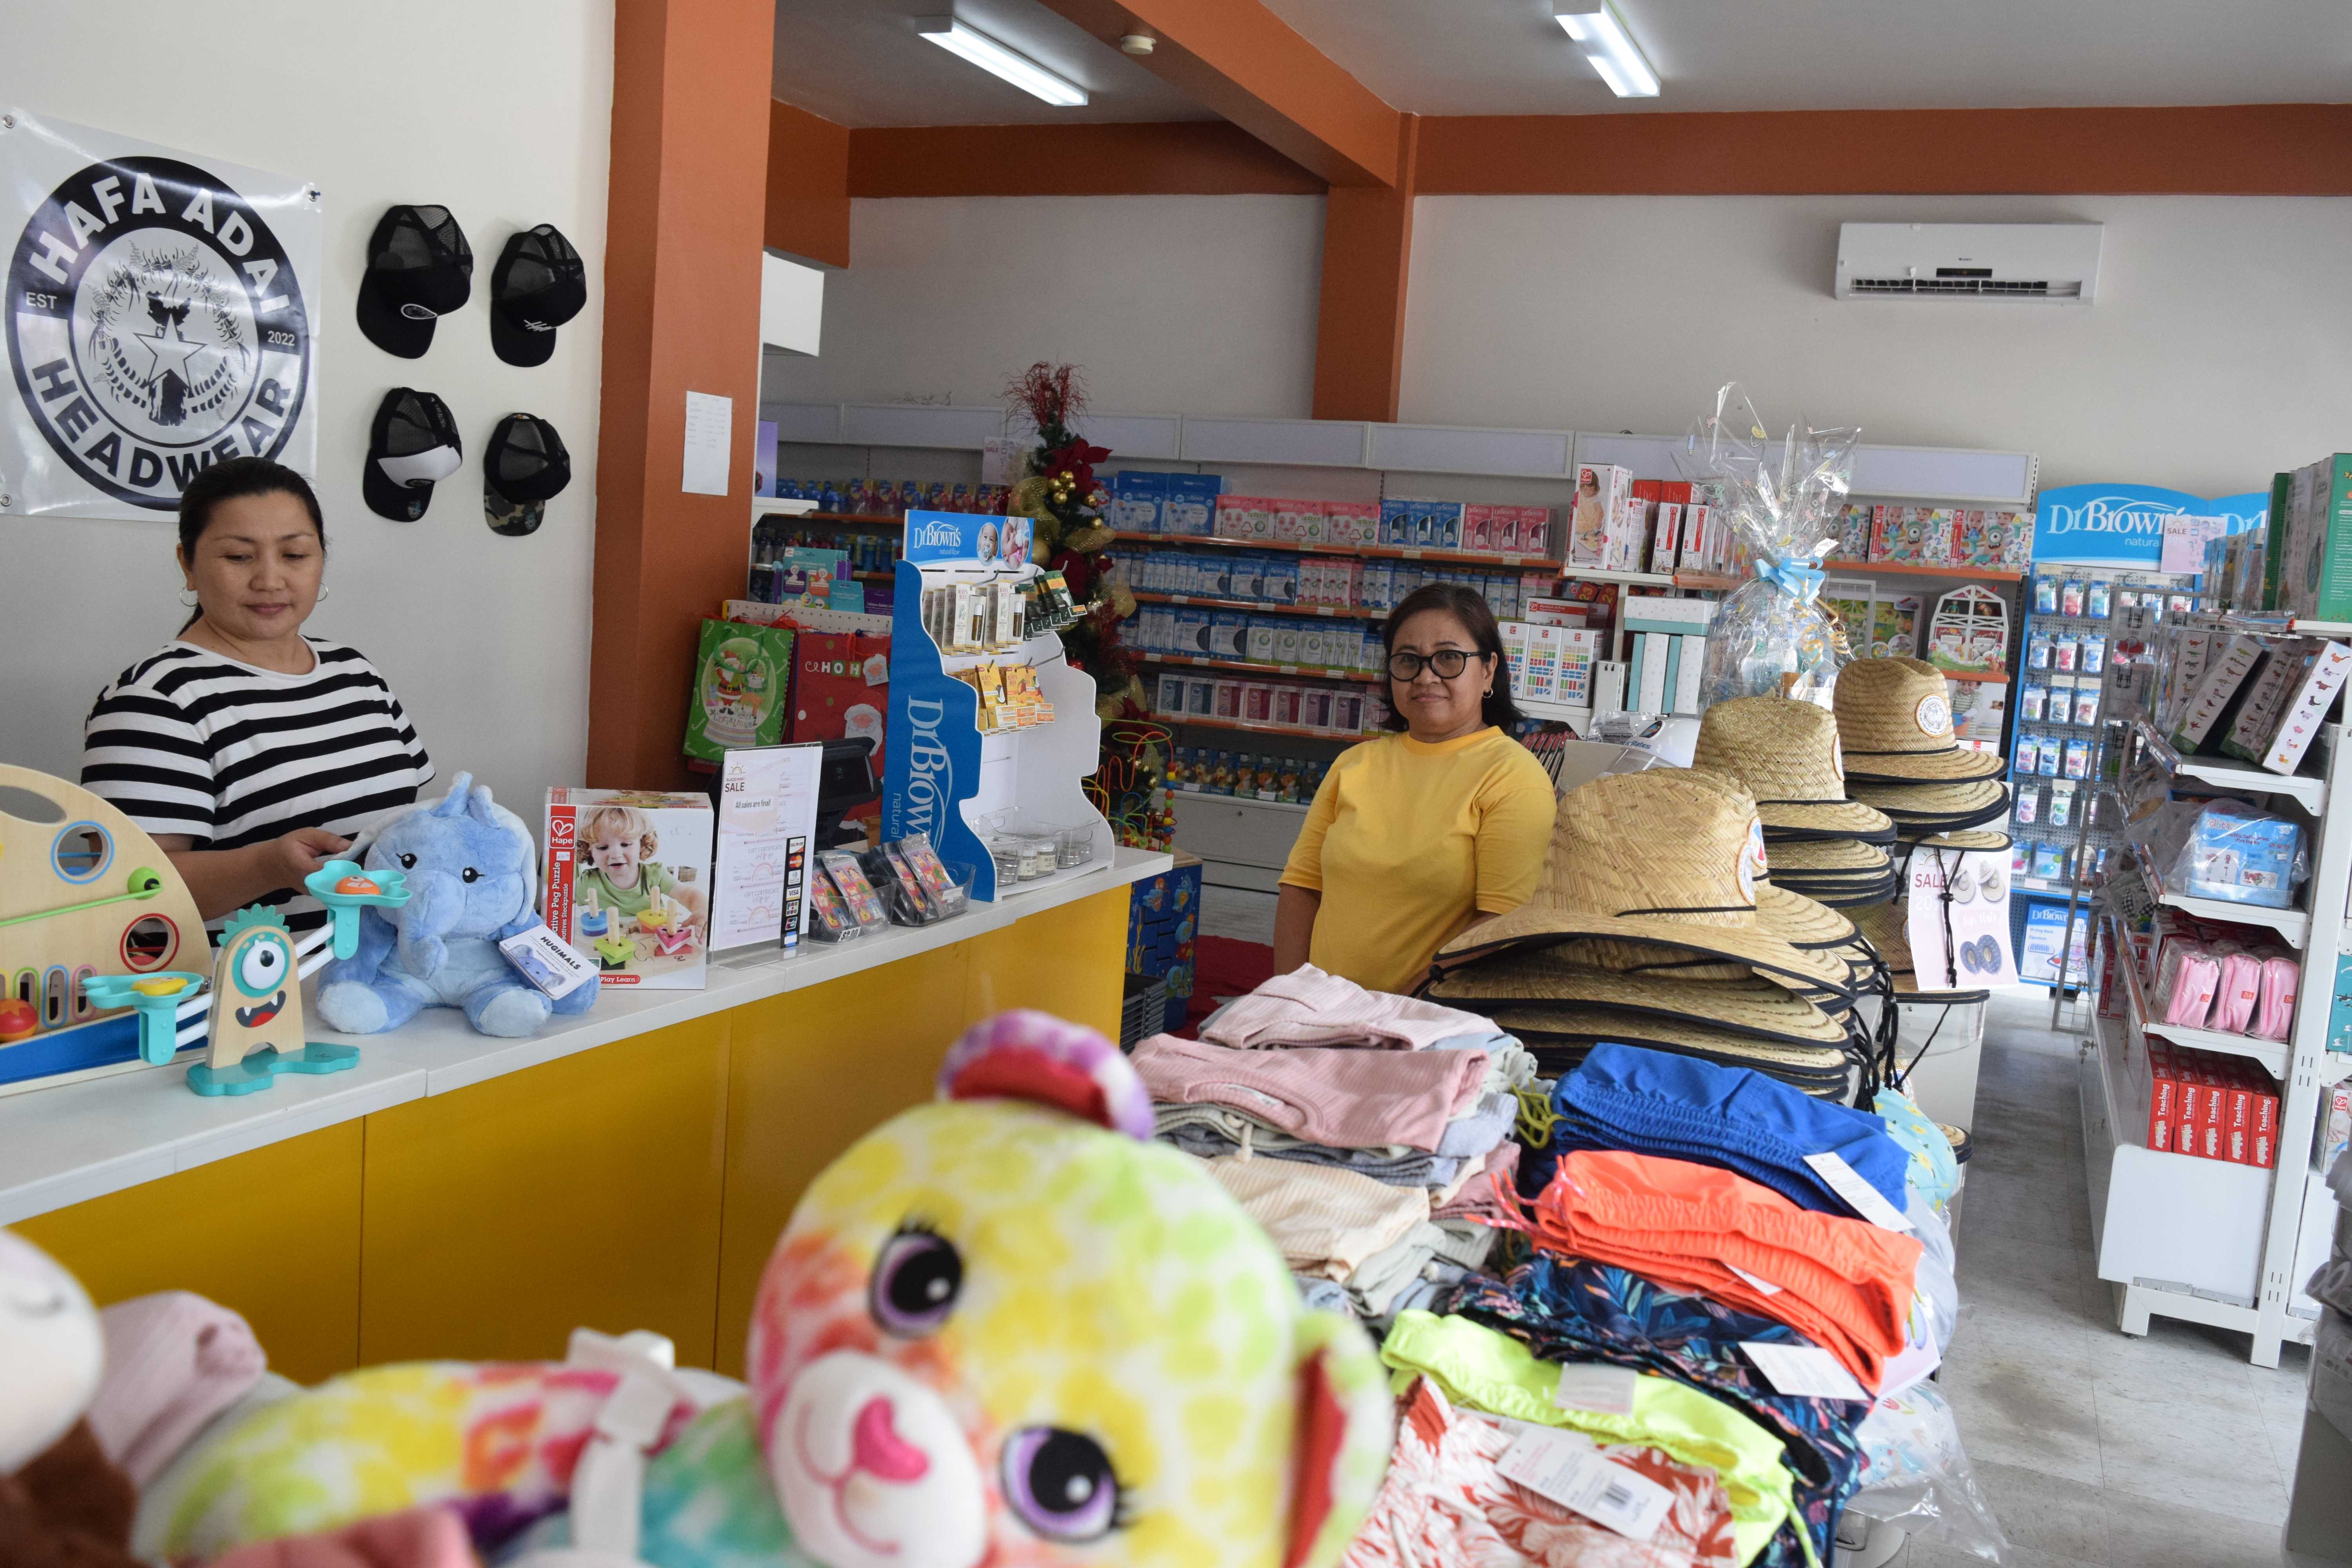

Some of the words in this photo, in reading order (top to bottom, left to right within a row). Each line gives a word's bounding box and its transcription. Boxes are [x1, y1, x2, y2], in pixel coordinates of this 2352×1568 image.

[30, 173, 166, 284] HAFA
[181, 188, 290, 314] ADAI
[26, 292, 57, 310] EST
[267, 330, 295, 347] 2022
[34, 357, 290, 492] HEADWEAR
[2047, 496, 2192, 534] DrBrow'
[2125, 537, 2159, 547] natura
[725, 782, 745, 792] SALE
[891, 793, 901, 839] natural
[552, 837, 573, 845] Hape
[552, 862, 560, 890] Puzzle
[1915, 873, 1948, 888] SALE
[552, 892, 561, 911] Peg
[754, 887, 780, 897] CERTIFICATE
[1962, 915, 1977, 927] Sun
[1980, 911, 1998, 924] Hats
[540, 936, 581, 970] HUGIMALS
[2158, 1084, 2170, 1116] Teaching
[2183, 1087, 2195, 1120] Teaching
[2208, 1091, 2220, 1123] Teaching
[2234, 1094, 2245, 1127] Teaching
[2259, 1100, 2271, 1132] Teaching
